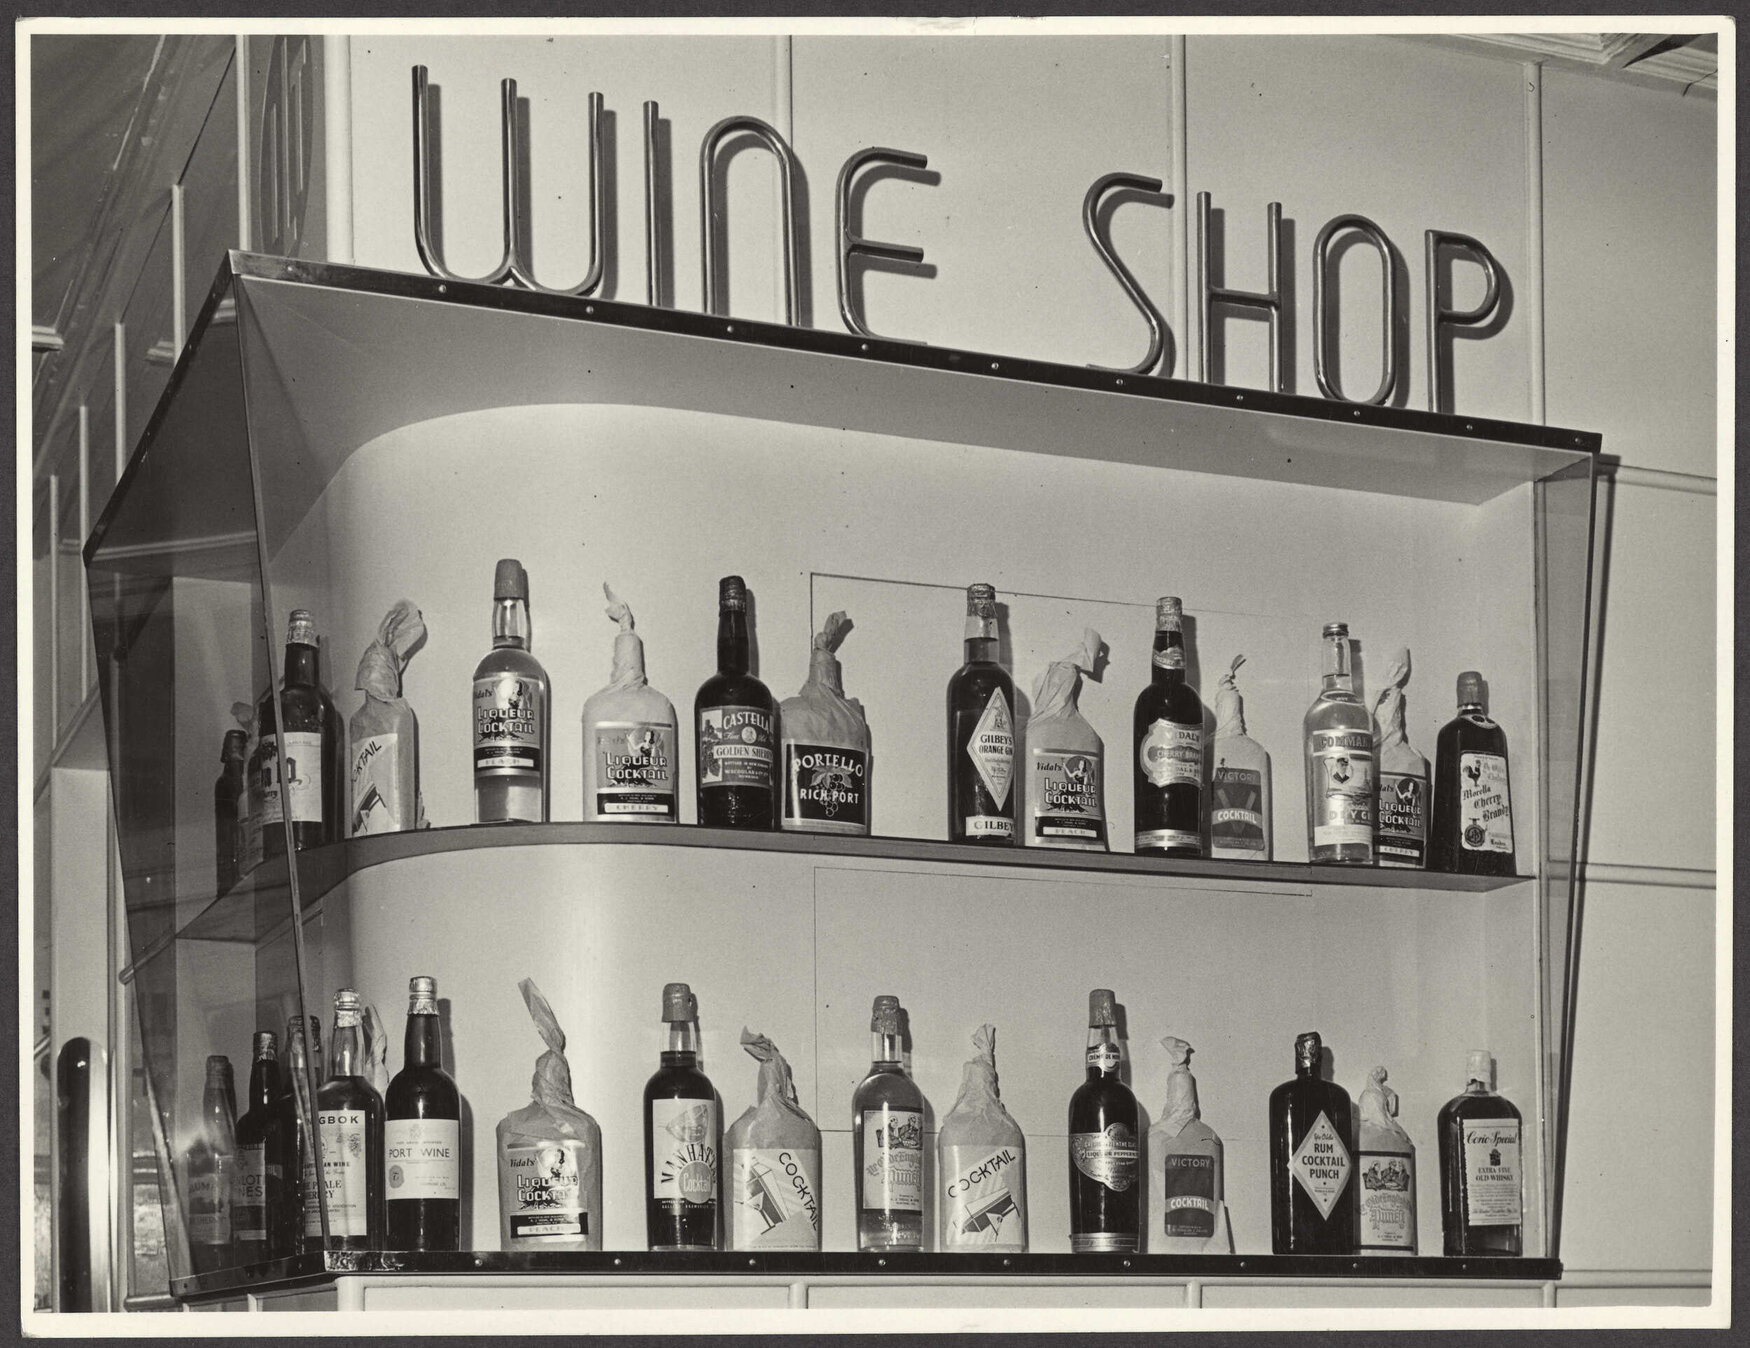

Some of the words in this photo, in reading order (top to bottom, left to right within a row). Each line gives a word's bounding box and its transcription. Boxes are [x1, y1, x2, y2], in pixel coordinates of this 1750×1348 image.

[411, 64, 928, 346] WINE
[1082, 171, 1500, 413] SHOP
[477, 707, 534, 721] LIQUEUR
[477, 719, 535, 735] COCKTAIL
[723, 711, 770, 735] CASTELLA
[980, 734, 1013, 745] GILBEY'S
[716, 747, 750, 758] GOLDEN
[979, 745, 1004, 755] ORANGE
[606, 752, 667, 768] LIQUEUR
[791, 753, 863, 777] PORTELLO
[606, 766, 668, 781] COCKTAIL
[1044, 777, 1096, 794] LIQUEUR
[800, 788, 828, 802] RICH
[831, 790, 859, 804] PORT
[1044, 790, 1097, 807] COCKTAIL
[1473, 793, 1502, 810] Cherry
[1217, 810, 1257, 825] COCKTAIL
[1378, 811, 1422, 828] COCKTAIL
[1490, 1131, 1518, 1147] Special
[388, 1148, 413, 1159] PORT
[420, 1148, 451, 1158] WINE
[1314, 1142, 1334, 1154] RUM
[1171, 1157, 1211, 1168] VICTORY
[1301, 1155, 1346, 1168] COCKTAIL
[948, 1149, 1017, 1199] COCKTAIL
[1309, 1168, 1340, 1180] PUNCH
[1475, 1174, 1490, 1182] OLD
[1477, 1167, 1497, 1175] EXTRA
[779, 1152, 818, 1232] COCKTAIL
[1170, 1197, 1209, 1211] COCKTAIL
